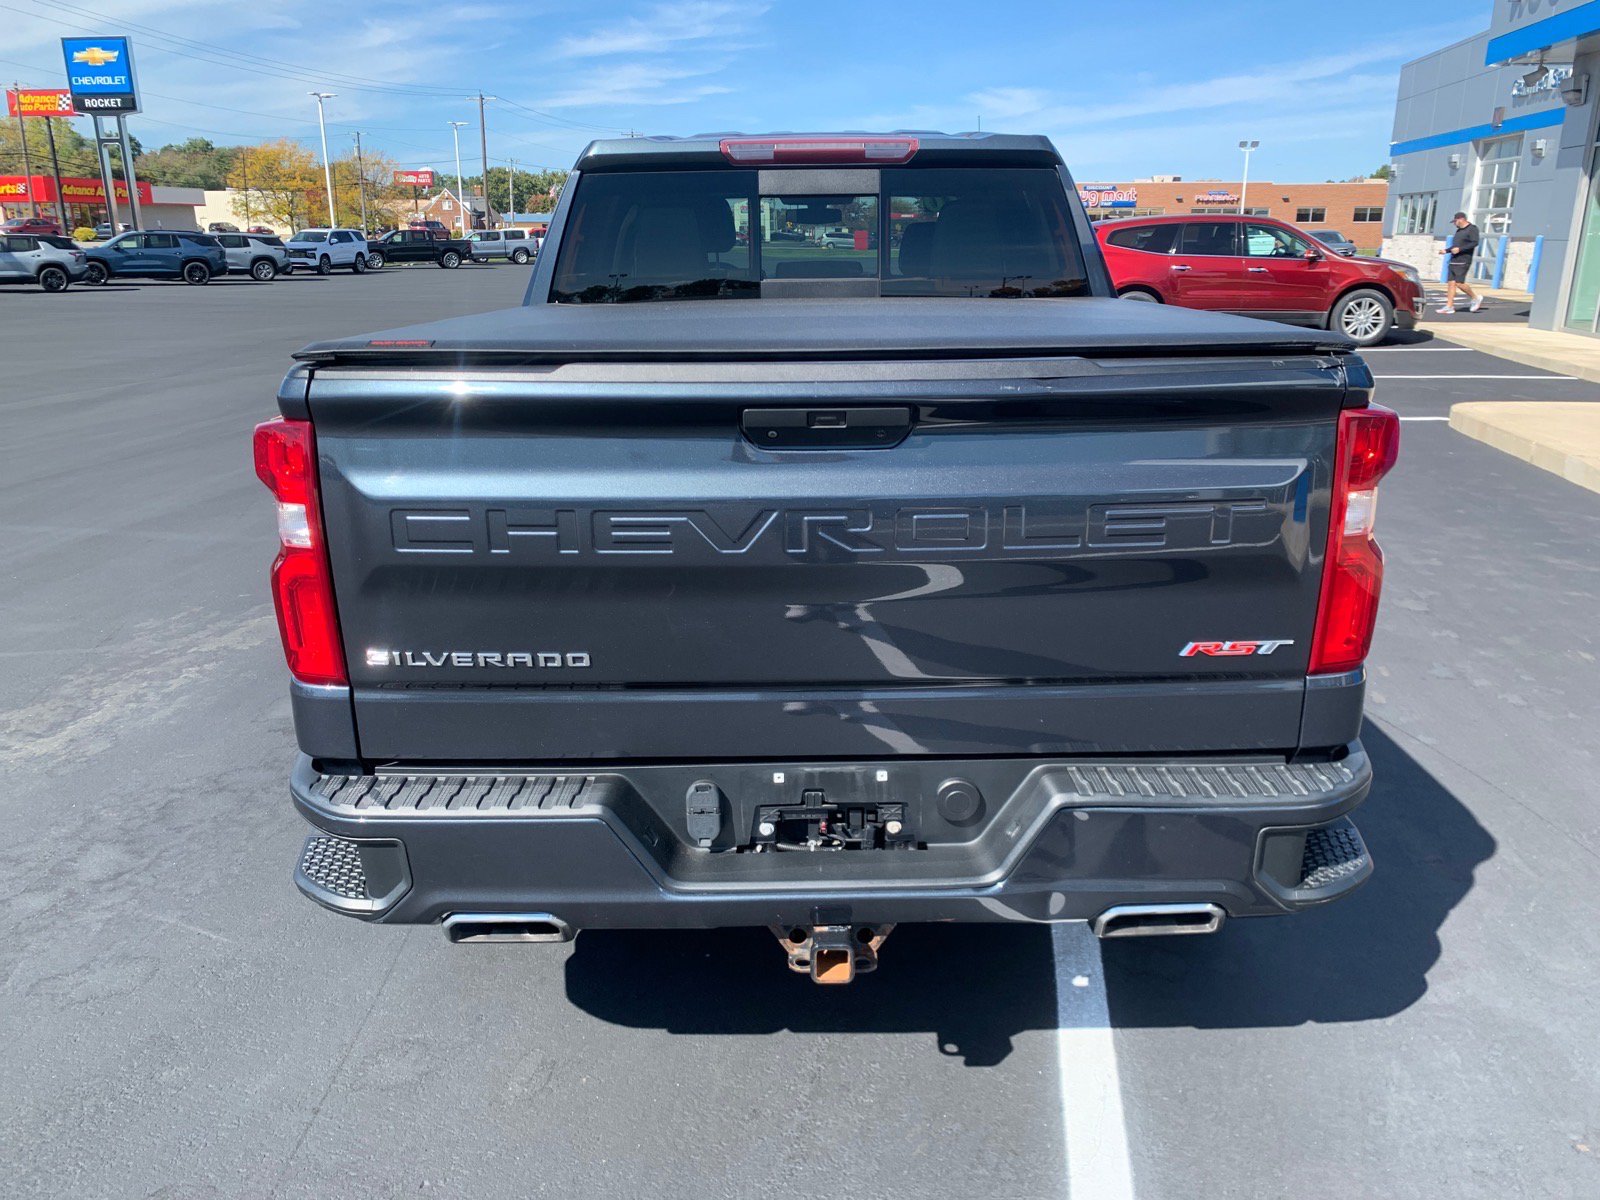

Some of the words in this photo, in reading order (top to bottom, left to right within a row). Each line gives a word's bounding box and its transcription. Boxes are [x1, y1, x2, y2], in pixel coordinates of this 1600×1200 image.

[72, 76, 126, 85] CHEVROLET
[19, 94, 56, 103] Advance
[84, 98, 122, 108] ROCKET
[33, 102, 56, 111] Parts
[61, 185, 95, 195] Advance
[1079, 191, 1099, 206] ug
[1101, 187, 1137, 201] mart
[392, 500, 1268, 556] CHEVROLET
[1179, 639, 1295, 657] RST
[366, 649, 591, 668] SILVERADO
